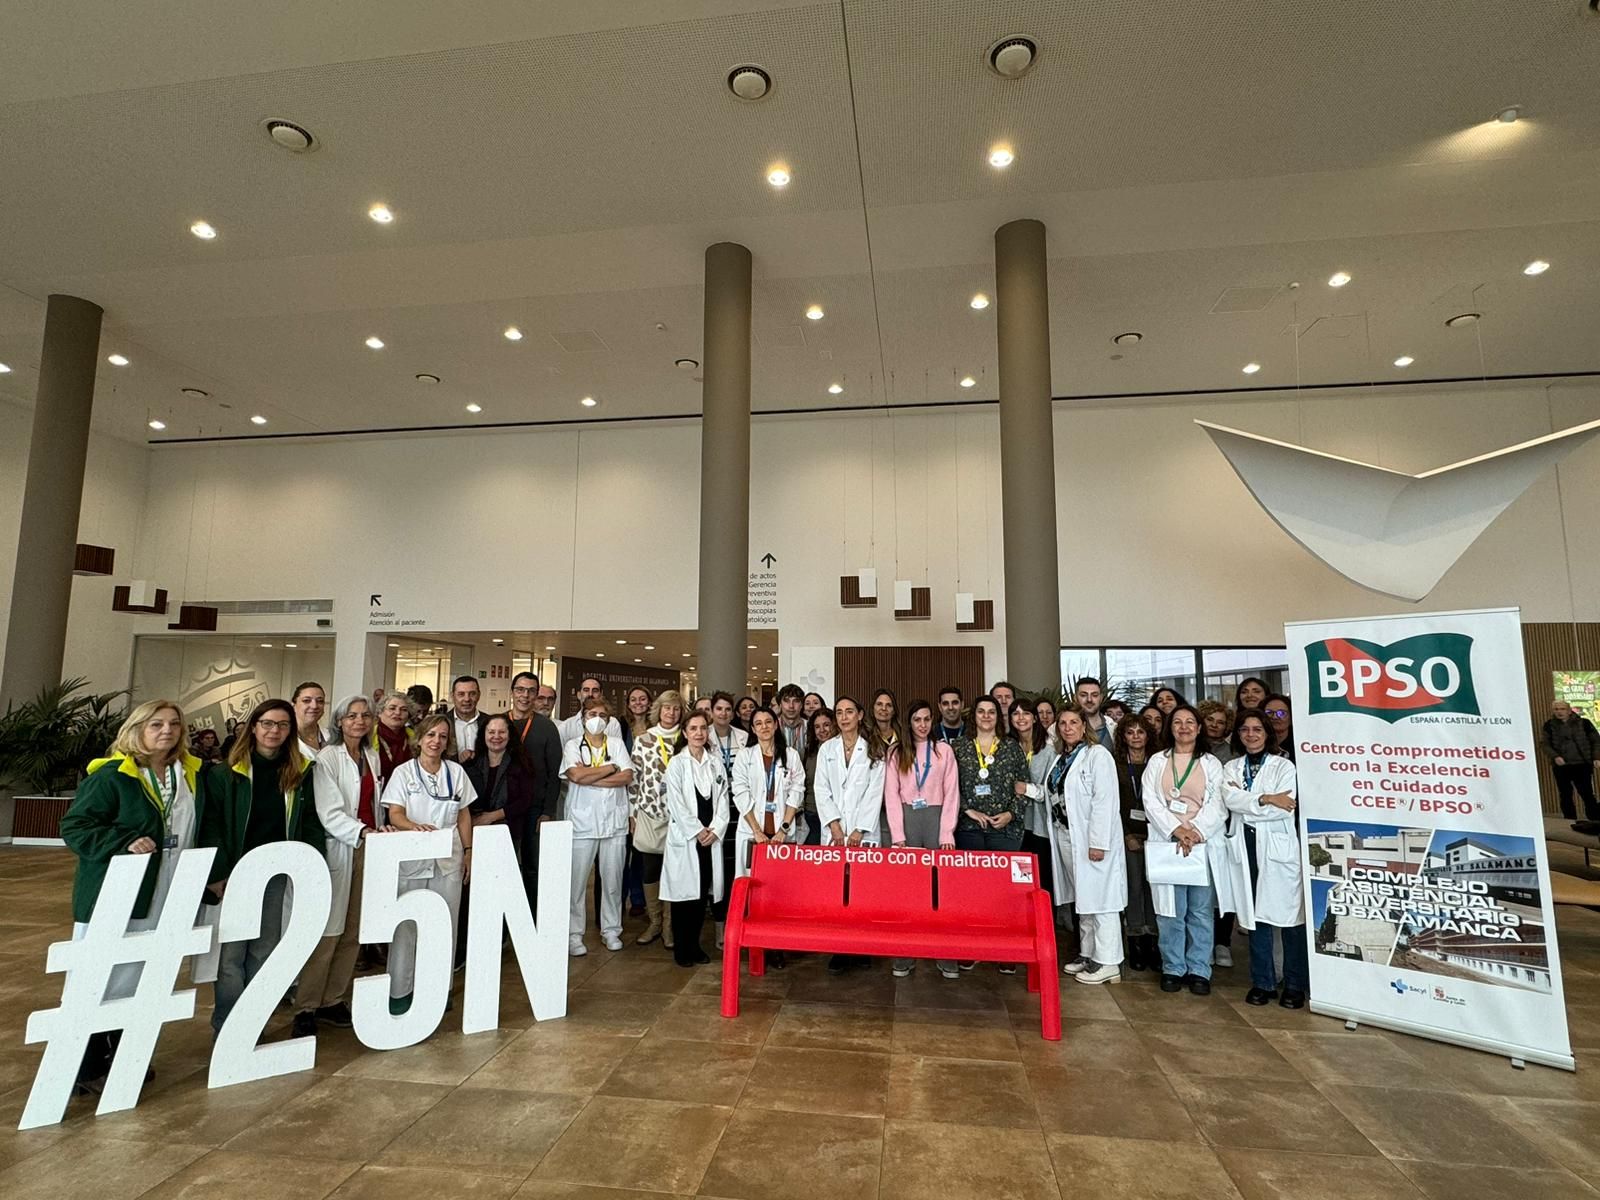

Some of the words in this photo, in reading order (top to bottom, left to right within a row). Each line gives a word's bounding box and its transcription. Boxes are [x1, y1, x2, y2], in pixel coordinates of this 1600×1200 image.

[1318, 656, 1460, 698] BPSO
[1410, 715, 1440, 724] ESPAÑA
[1445, 716, 1481, 725] CASTILLA
[1482, 717, 1489, 725] Y
[1490, 717, 1512, 725] LEÓN
[1301, 742, 1365, 755] Centros
[1371, 743, 1526, 760] Comprometidos
[1329, 762, 1360, 772] con
[1367, 760, 1382, 773] la
[1388, 761, 1490, 778] Excelencia
[1352, 779, 1374, 790] en
[1380, 778, 1468, 795] Cuidados
[1408, 798, 1415, 811] /
[766, 845, 790, 860] NO
[794, 848, 841, 865] hagas
[845, 849, 883, 864] trato
[887, 853, 917, 864] con
[921, 850, 936, 866] el
[938, 853, 1009, 869] maltrato
[1350, 867, 1488, 895] COMPLEJO
[1328, 889, 1521, 927] UNIVERSITARIO
[1340, 880, 1505, 911] ASISTENCIAL
[1352, 906, 1522, 942] SALAMANCA
[18, 820, 572, 1131] #25N
